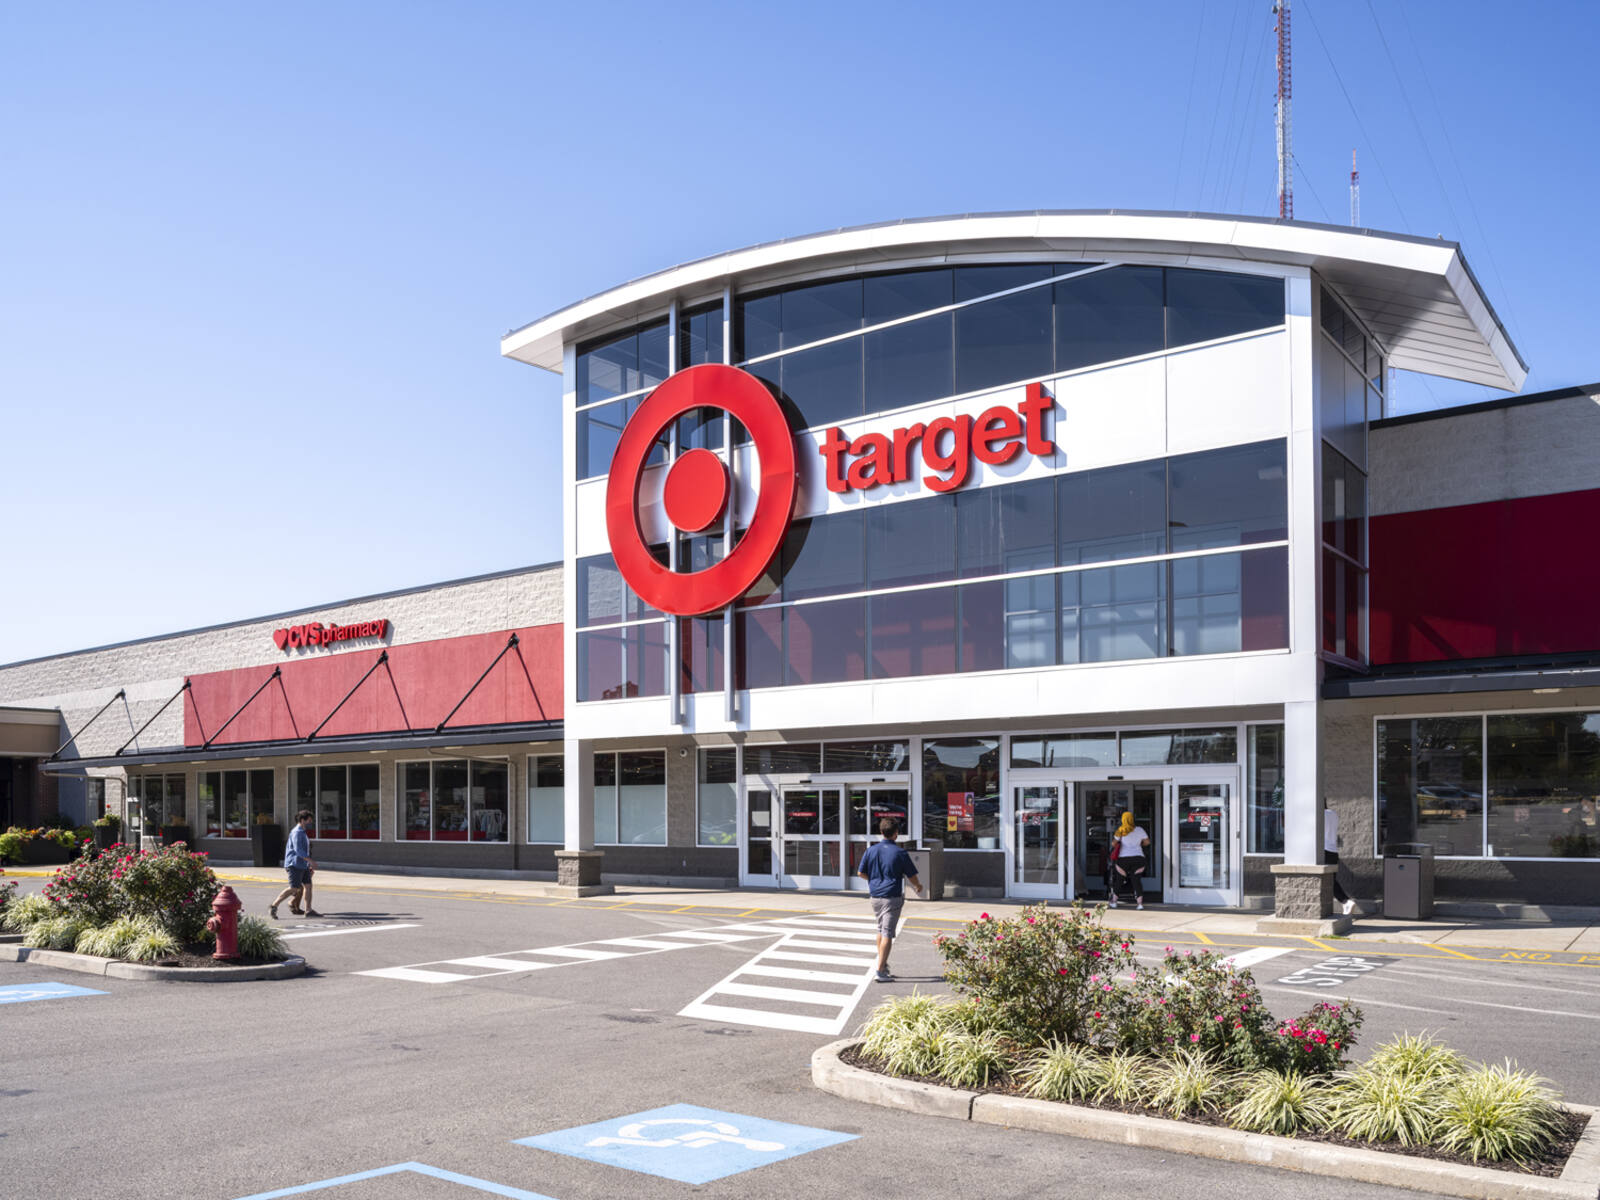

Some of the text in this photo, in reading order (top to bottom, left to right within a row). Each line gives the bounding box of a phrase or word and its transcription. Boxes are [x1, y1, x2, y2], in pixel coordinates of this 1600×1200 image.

[819, 381, 1054, 493] target
[287, 618, 389, 649] CVS pharmacy
[1500, 951, 1552, 960] NO
[1278, 956, 1385, 987] STOP
